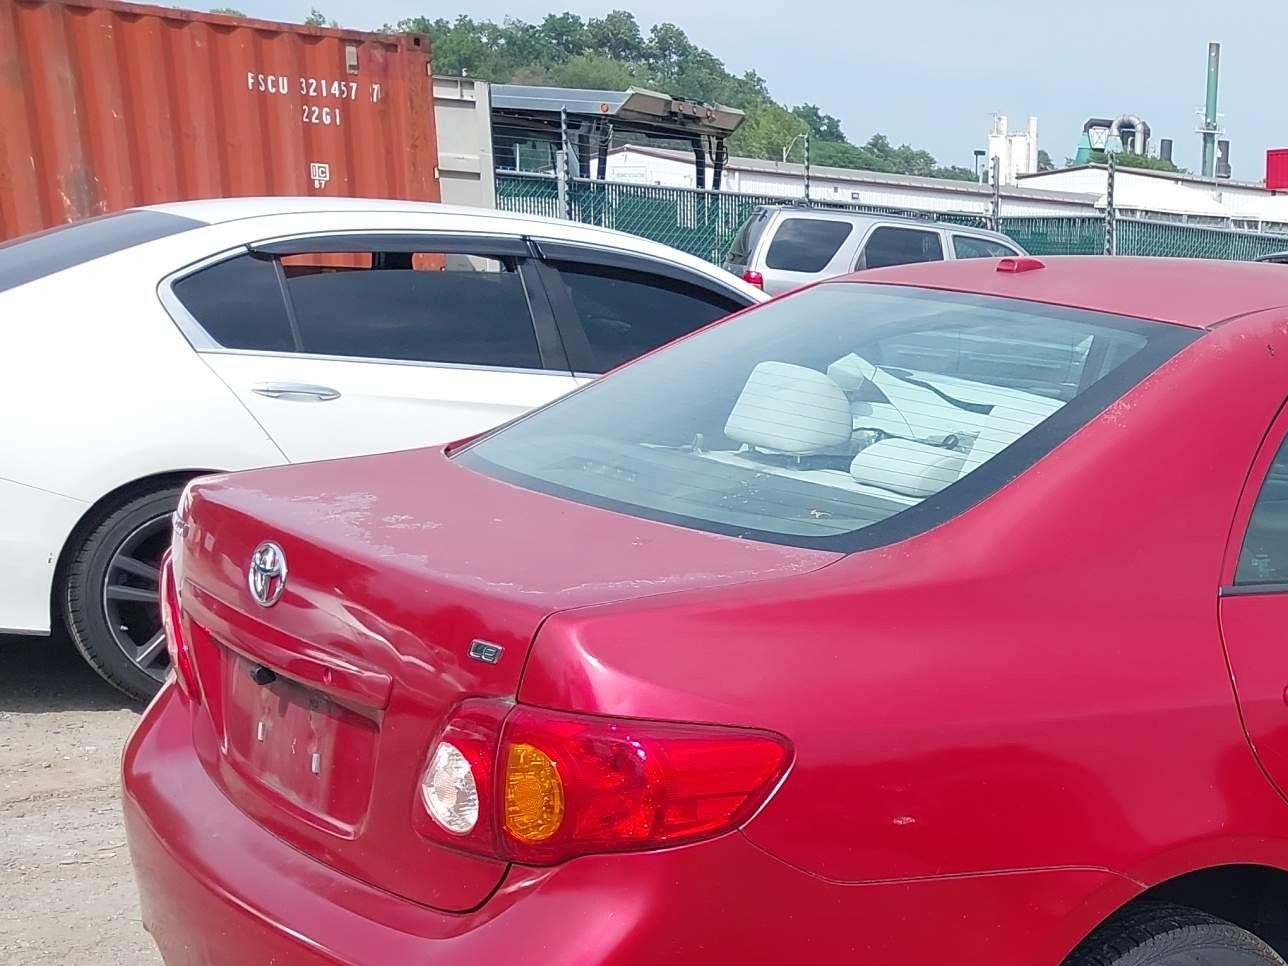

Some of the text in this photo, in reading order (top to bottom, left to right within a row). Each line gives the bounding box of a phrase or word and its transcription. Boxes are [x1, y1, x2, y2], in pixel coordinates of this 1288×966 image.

[247, 72, 288, 94] FSCU
[300, 78, 357, 100] 321457
[303, 105, 340, 125] 22G1
[471, 642, 499, 662] LE
